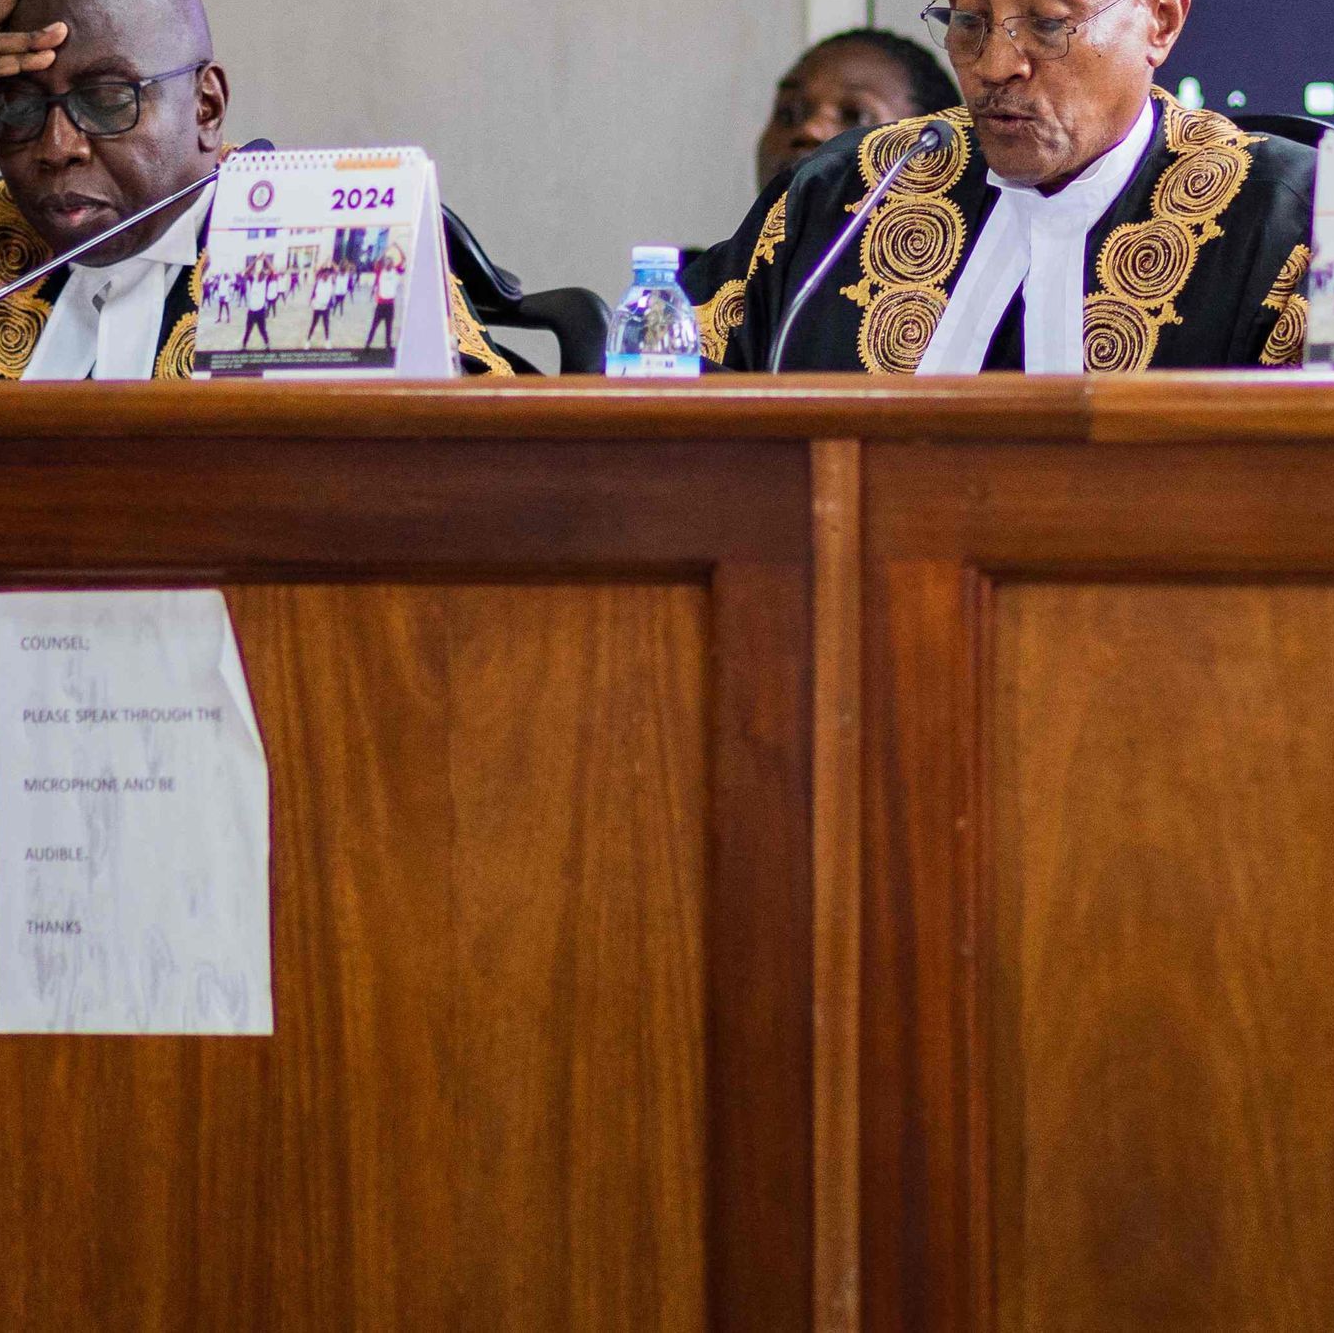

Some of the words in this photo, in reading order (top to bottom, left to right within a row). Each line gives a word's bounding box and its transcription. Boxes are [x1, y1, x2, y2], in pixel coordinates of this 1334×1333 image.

[331, 187, 395, 210] 2024
[23, 708, 71, 723] PLEASE
[76, 708, 118, 723] SPEAK
[123, 707, 193, 722] THROUGH
[196, 707, 224, 722] THE
[24, 778, 119, 793] MICROPHONE
[123, 778, 155, 792] AND
[158, 777, 176, 792] BE
[26, 920, 83, 935] THANKS
